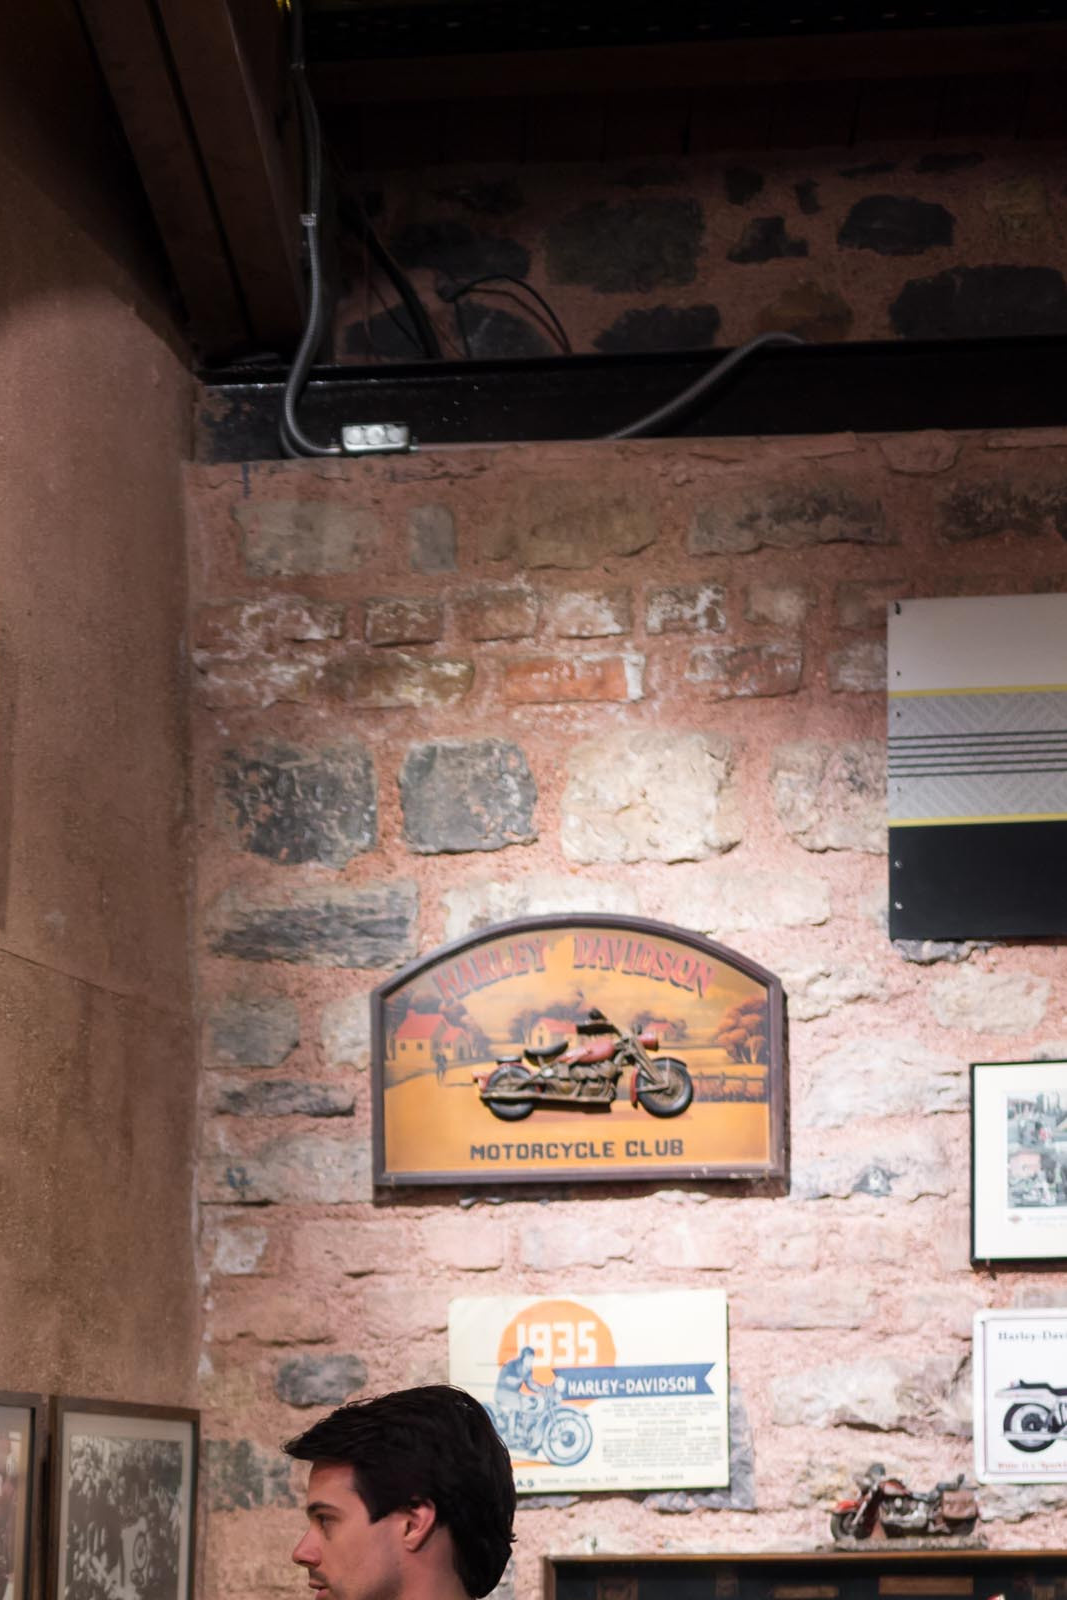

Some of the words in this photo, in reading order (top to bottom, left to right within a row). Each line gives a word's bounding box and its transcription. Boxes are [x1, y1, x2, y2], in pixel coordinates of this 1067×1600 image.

[434, 936, 547, 1001] HARLEY
[573, 935, 716, 997] DAVIDSON
[470, 1141, 615, 1161] MOTORCYCLE
[625, 1139, 684, 1157] CLUB
[516, 1321, 598, 1367] 1935
[568, 1375, 697, 1395] HARLEY-DAVIDSON
